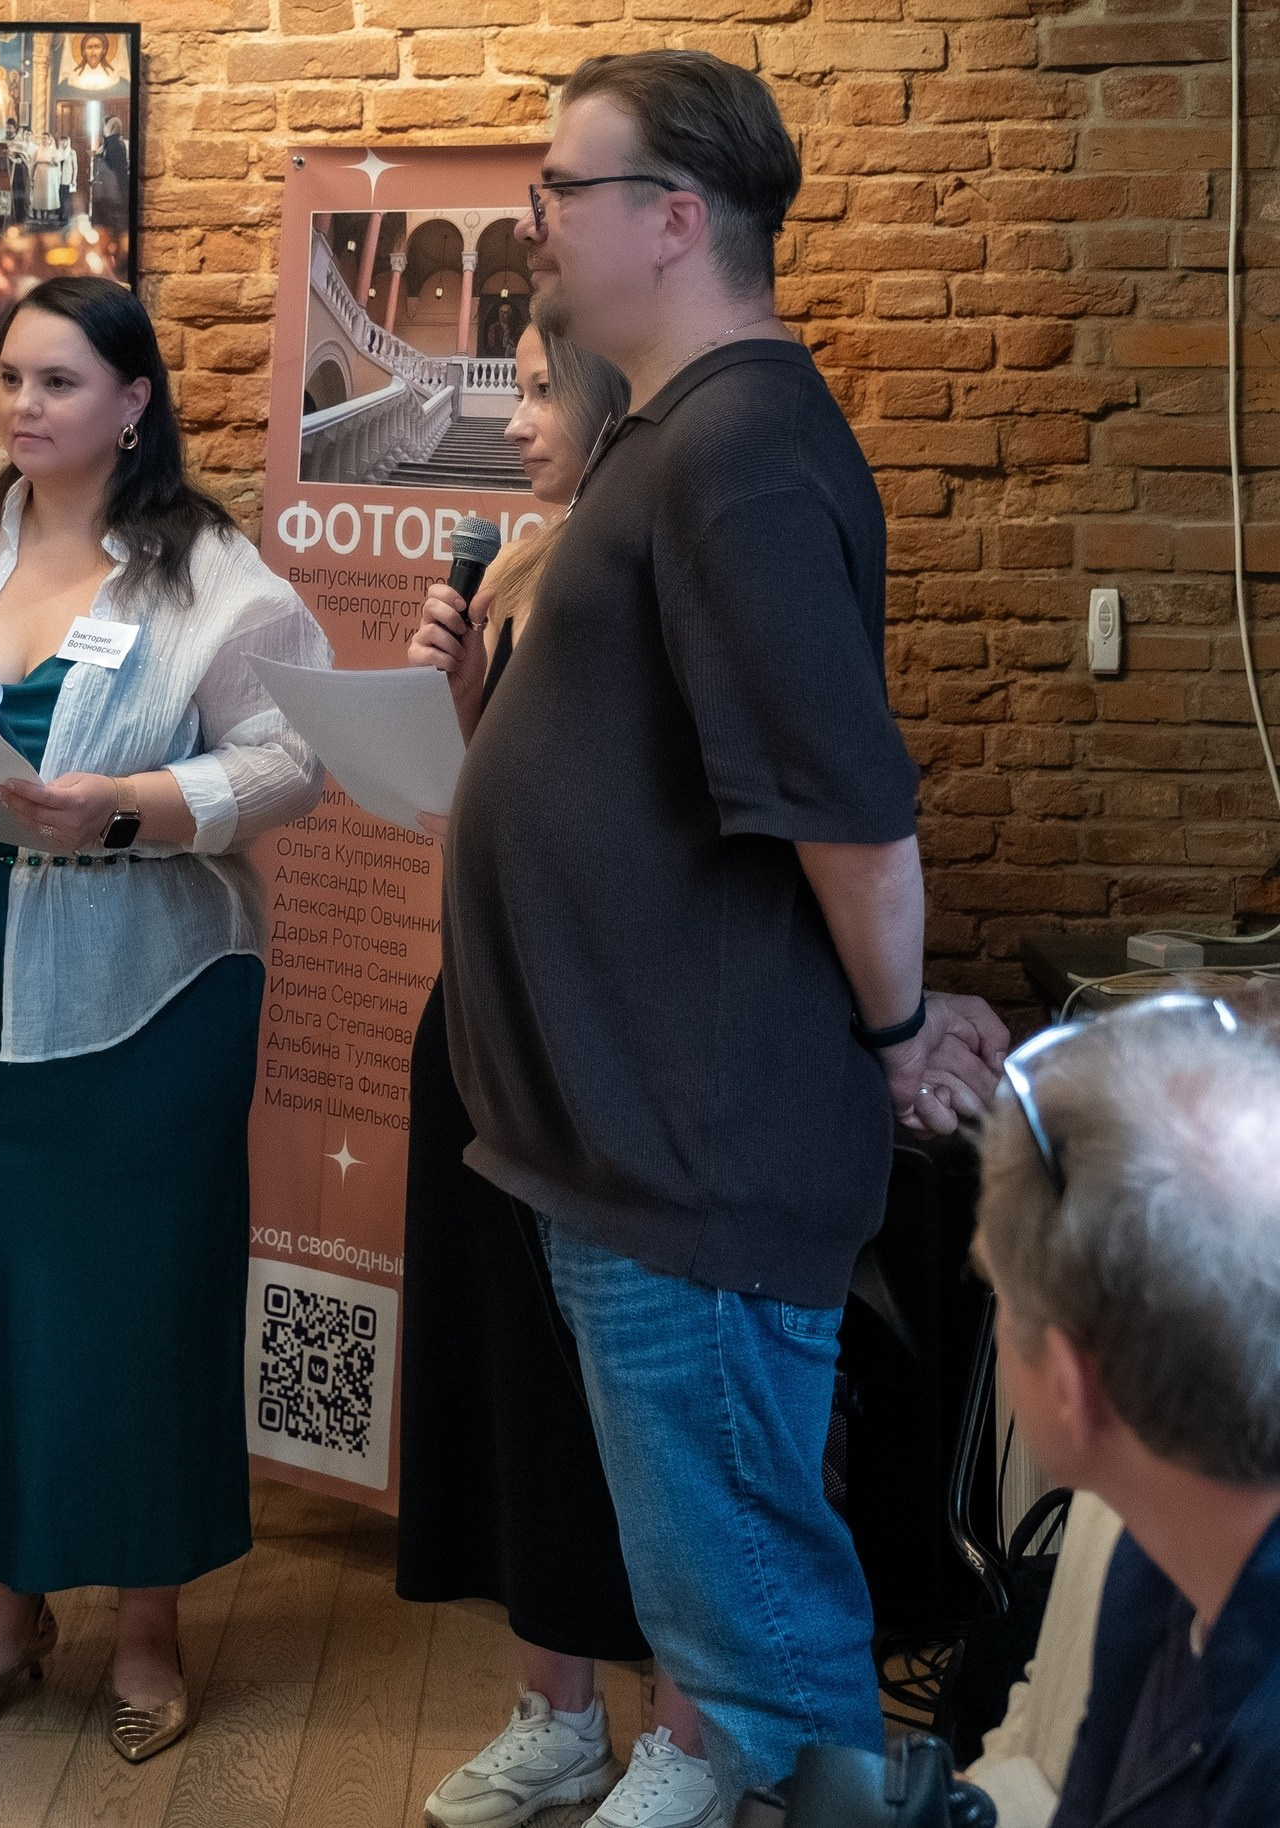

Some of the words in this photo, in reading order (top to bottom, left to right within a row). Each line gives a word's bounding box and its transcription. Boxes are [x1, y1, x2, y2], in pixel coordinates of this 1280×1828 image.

[288, 567, 408, 590] выпускников
[316, 594, 424, 619] переподгот
[71, 630, 112, 644] Виктория
[361, 620, 400, 642] МГУ
[341, 816, 434, 846] Кошманова
[276, 837, 330, 861] Ольга
[335, 844, 430, 875] Куприянова
[274, 865, 368, 897] Александр
[372, 877, 406, 903] Мец
[273, 893, 366, 925] Александр
[271, 921, 328, 945] Дарья
[332, 929, 407, 957] Роточева
[271, 948, 363, 979] Валентина
[269, 976, 327, 1001] Ирина
[331, 985, 408, 1015] Серегина
[268, 1004, 322, 1028] Ольга
[326, 1012, 412, 1045] Степанова
[266, 1031, 340, 1059] Альбина
[345, 1043, 410, 1074] Туляков
[266, 1059, 354, 1091] Елизавета
[358, 1075, 410, 1102] Филат
[264, 1087, 322, 1113] Мария
[327, 1096, 410, 1131] Шмельков
